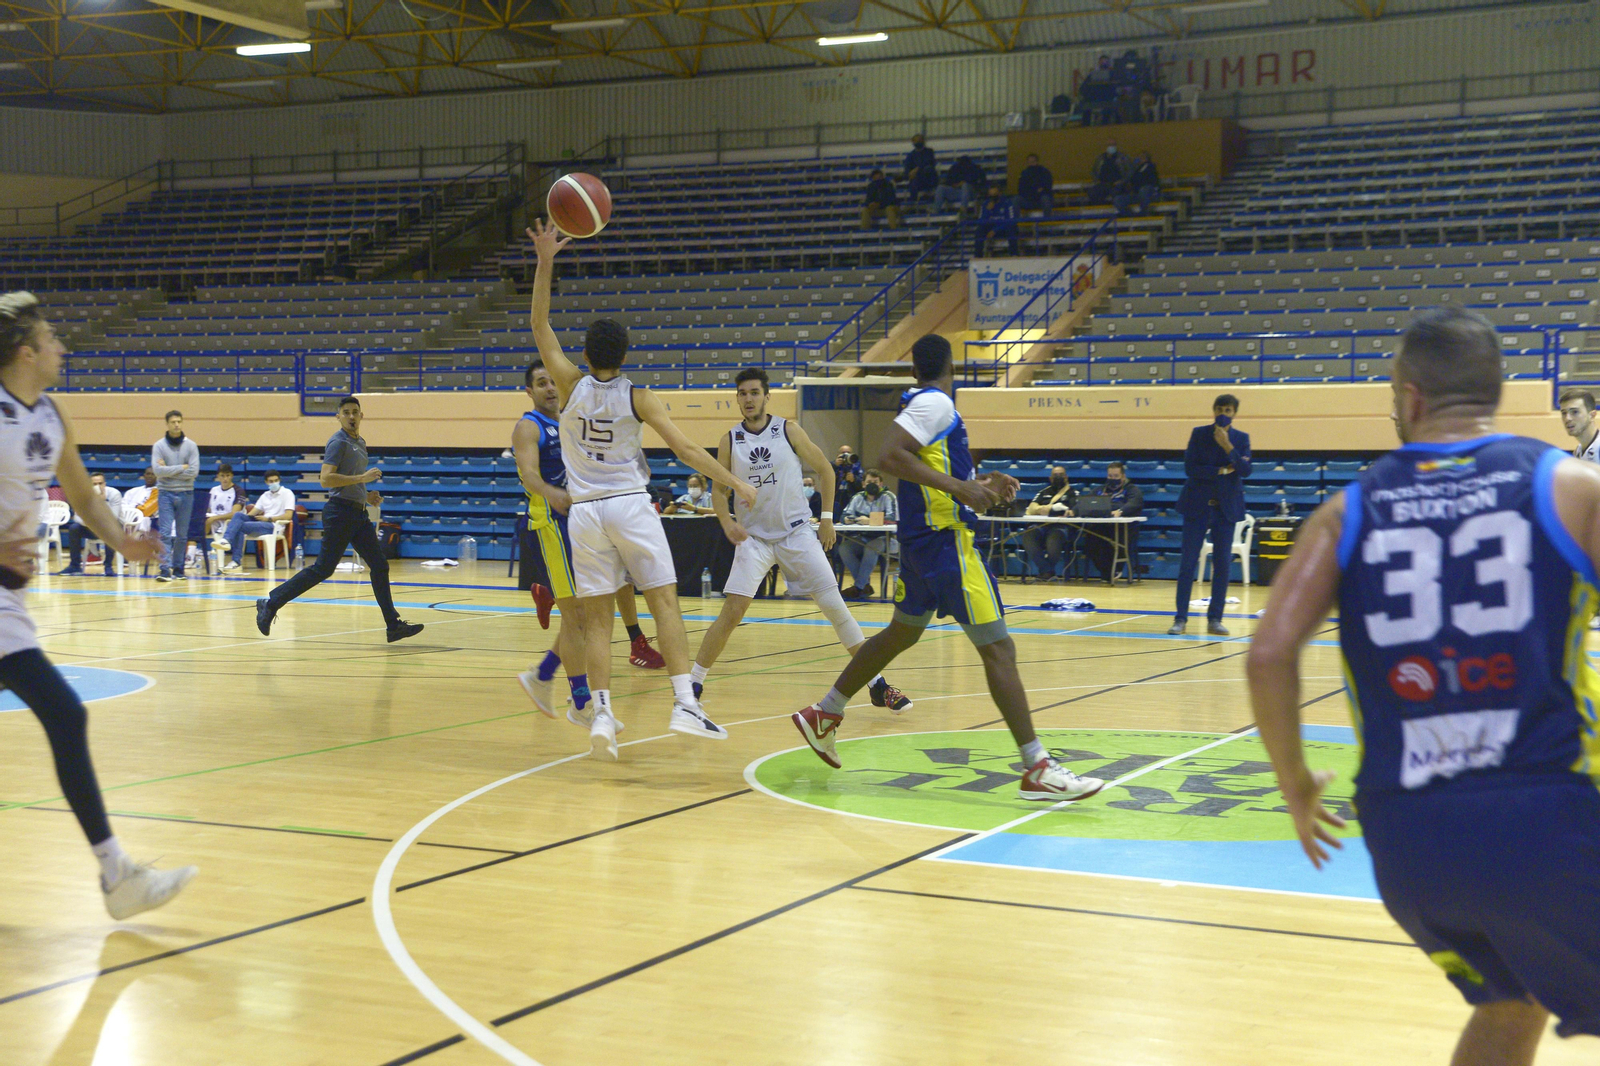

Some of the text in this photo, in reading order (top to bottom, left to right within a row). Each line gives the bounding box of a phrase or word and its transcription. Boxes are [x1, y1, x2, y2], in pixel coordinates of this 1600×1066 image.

[1002, 285, 1066, 298] de Deptes
[1028, 397, 1152, 408] PRENSA TV
[577, 416, 613, 443] 15
[748, 462, 774, 472] HUAWEI
[747, 471, 778, 489] 34
[1362, 509, 1534, 647] 33
[1437, 646, 1516, 695] ice
